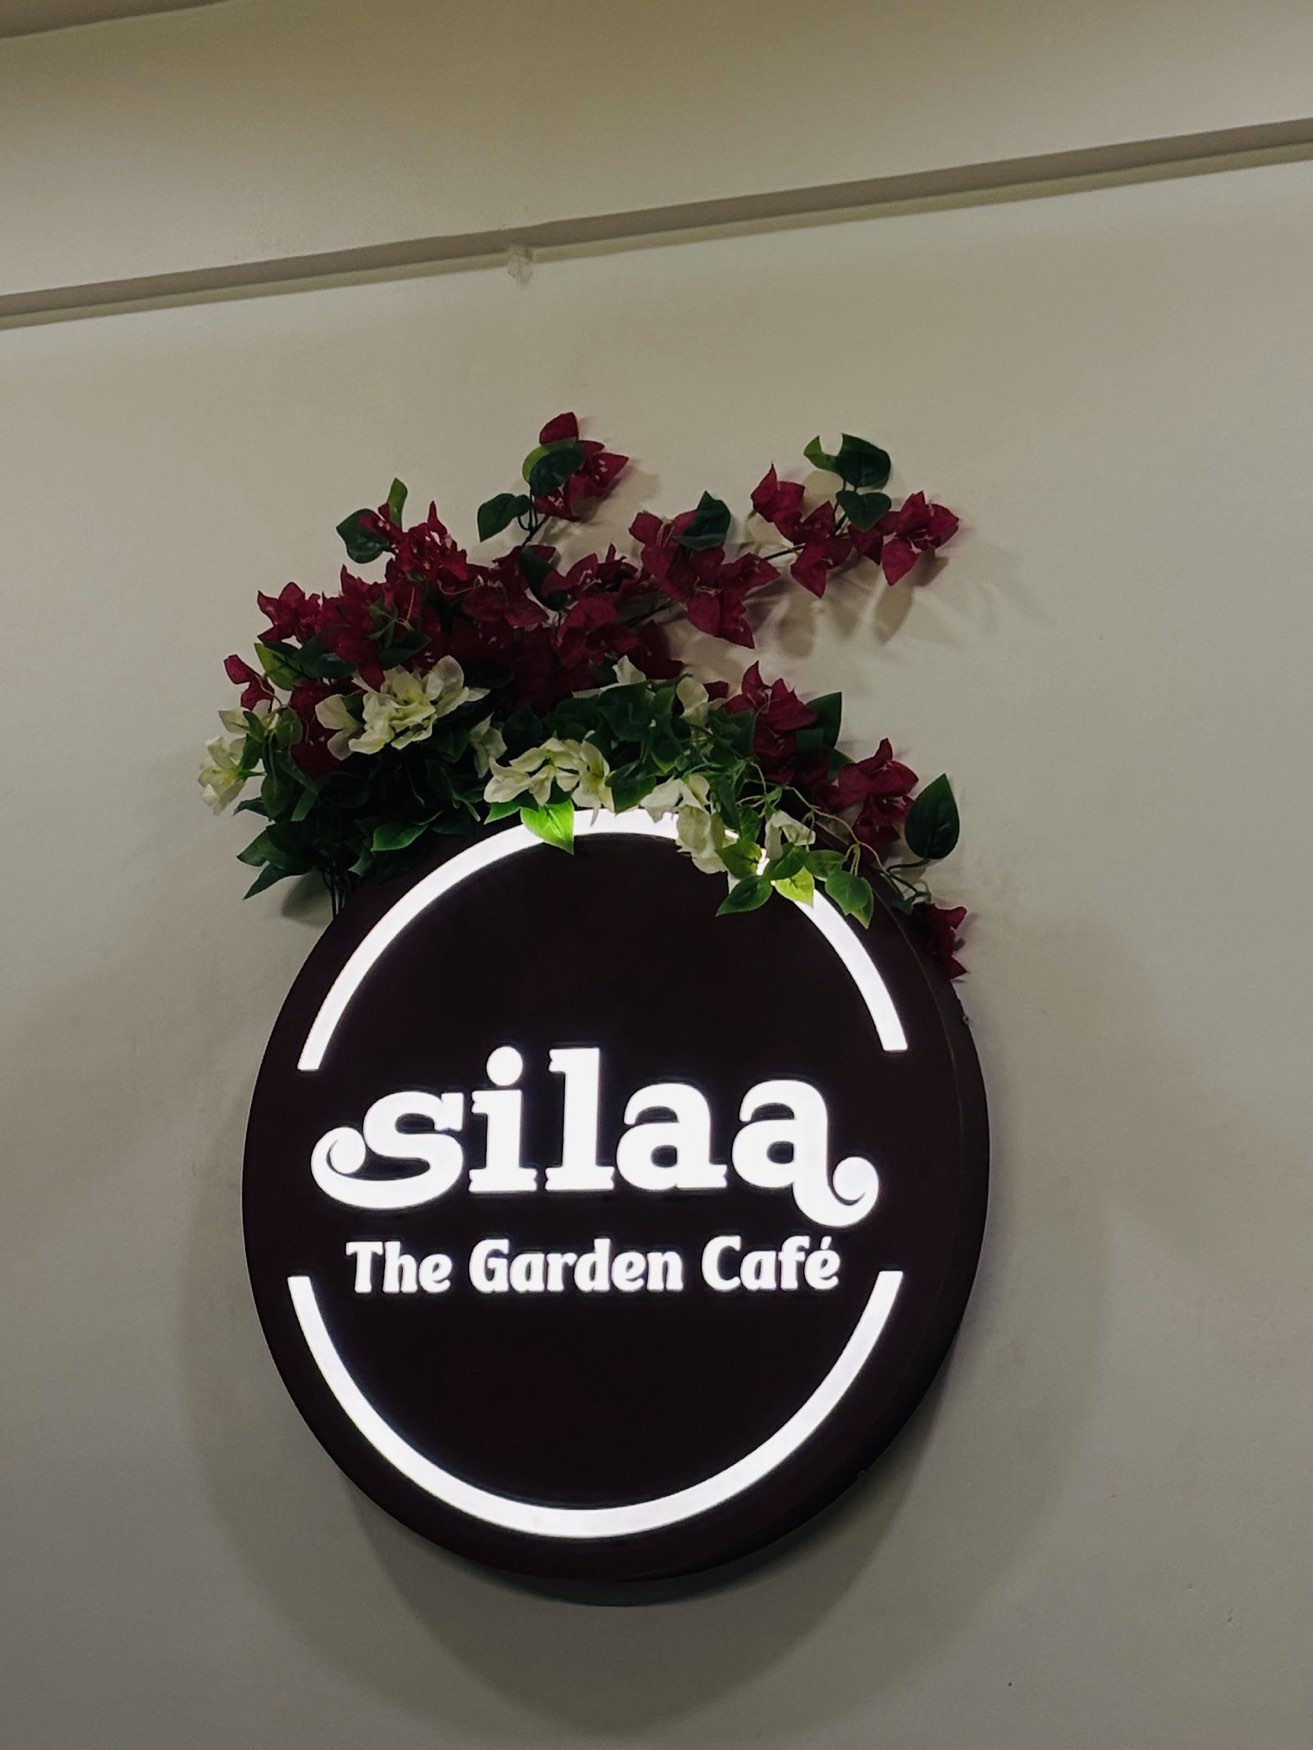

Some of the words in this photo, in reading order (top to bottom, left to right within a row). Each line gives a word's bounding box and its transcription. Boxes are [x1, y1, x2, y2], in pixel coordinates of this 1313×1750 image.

[310, 1046, 880, 1228] silaa
[345, 1241, 453, 1293] The
[469, 1238, 684, 1294] Garden
[701, 1235, 841, 1292] Café
